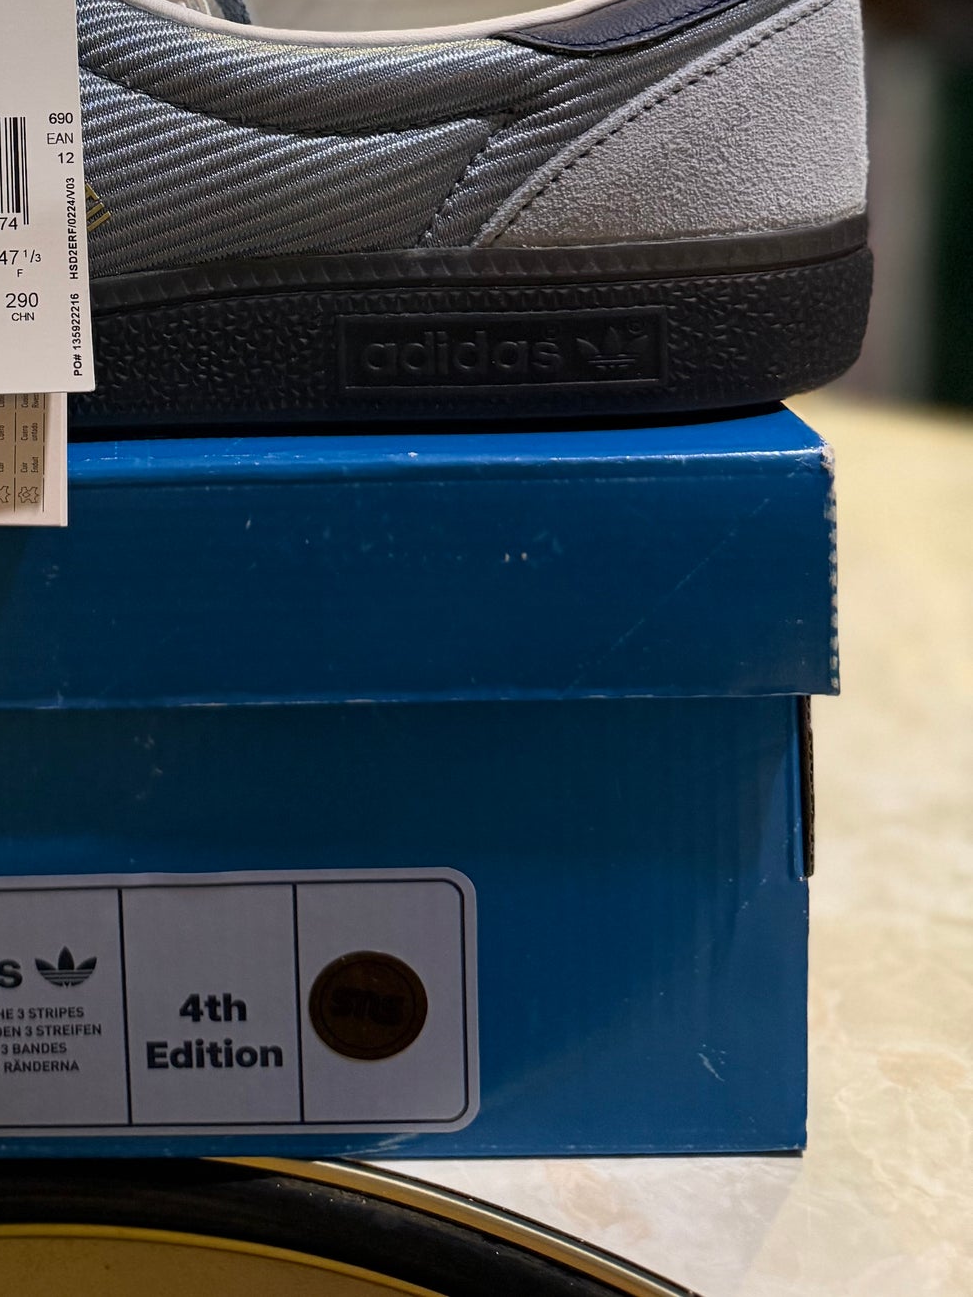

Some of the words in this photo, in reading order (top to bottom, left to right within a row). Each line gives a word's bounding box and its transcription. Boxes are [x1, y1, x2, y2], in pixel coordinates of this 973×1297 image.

[49, 113, 74, 124] 690
[47, 132, 74, 144] EAN
[58, 153, 74, 164] 12
[66, 177, 79, 280] HSD2ERF/0224/V03
[17, 269, 23, 277] F
[5, 292, 39, 308] 290
[11, 312, 35, 321] CHN
[72, 293, 81, 350] 135922216
[364, 331, 562, 375] adidas
[74, 352, 83, 376] PO#
[31, 457, 39, 473] Enduit
[17, 1008, 25, 1020] 3
[28, 1006, 85, 1019] STRIPES
[179, 993, 247, 1023] 4th
[25, 1026, 32, 1037] 3
[36, 1024, 102, 1037] STREIFEN
[1, 1044, 9, 1055] 3
[13, 1042, 67, 1054] BANDES
[145, 1038, 283, 1070] Edition
[4, 1059, 80, 1072] RÄNDERNA
